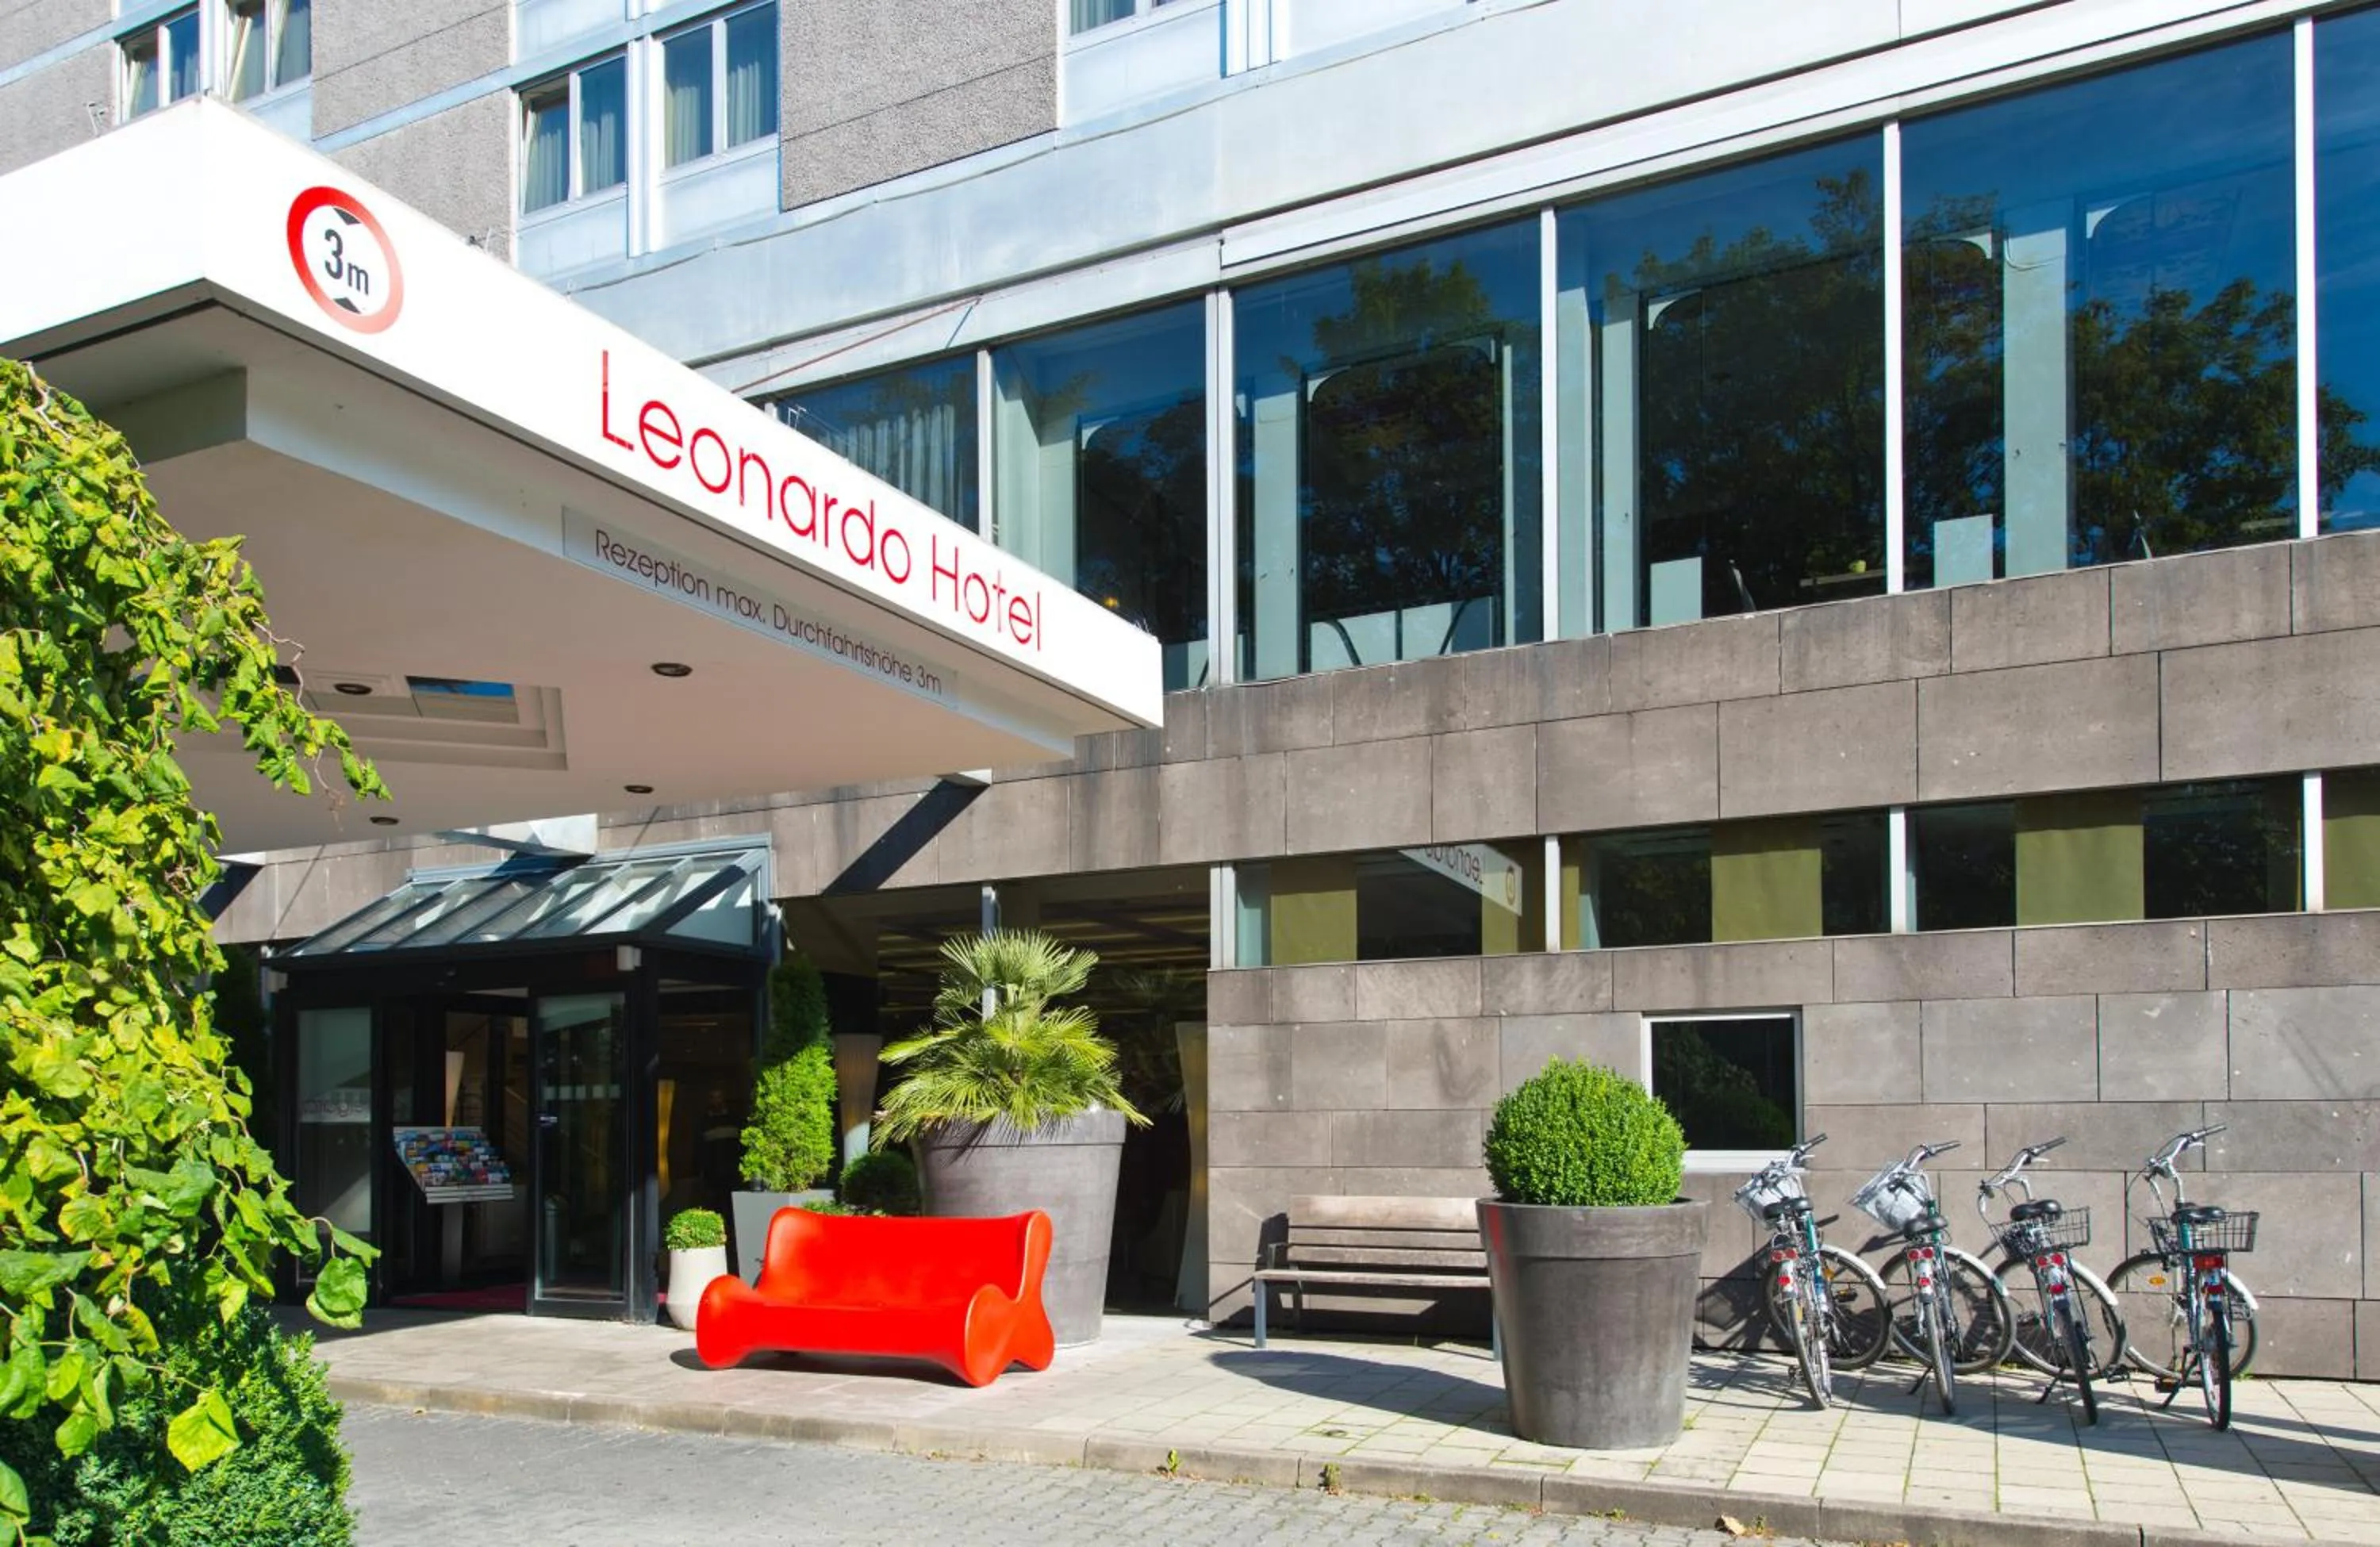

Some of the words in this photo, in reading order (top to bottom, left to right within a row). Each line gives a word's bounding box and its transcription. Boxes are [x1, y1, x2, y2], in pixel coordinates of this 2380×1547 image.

[596, 529, 709, 601] Rezeption
[716, 585, 766, 623] max.
[774, 604, 912, 682] Durchfahrtshöhe
[917, 665, 942, 695] 3m
[602, 350, 911, 584] Leonardo
[932, 533, 1041, 651] Hotel
